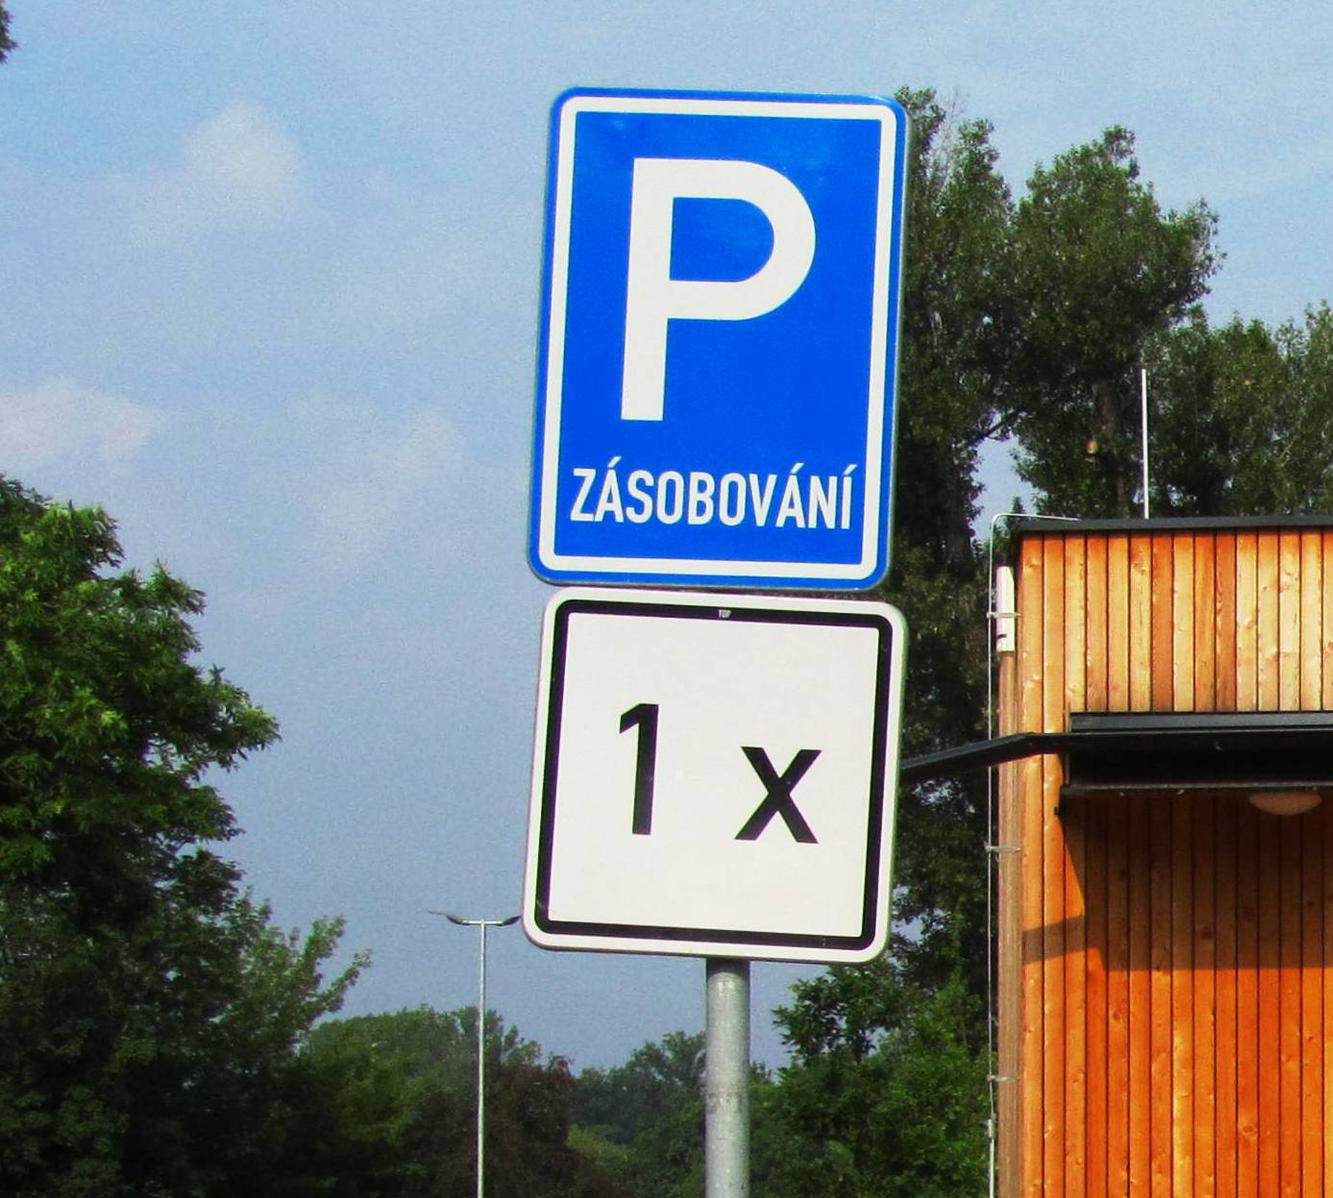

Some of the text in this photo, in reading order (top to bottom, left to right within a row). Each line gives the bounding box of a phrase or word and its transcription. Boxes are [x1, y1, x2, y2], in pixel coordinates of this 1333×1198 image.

[620, 157, 816, 422] P
[570, 456, 858, 530] ZÁSOBOVÁNÍ
[619, 702, 660, 836] 1
